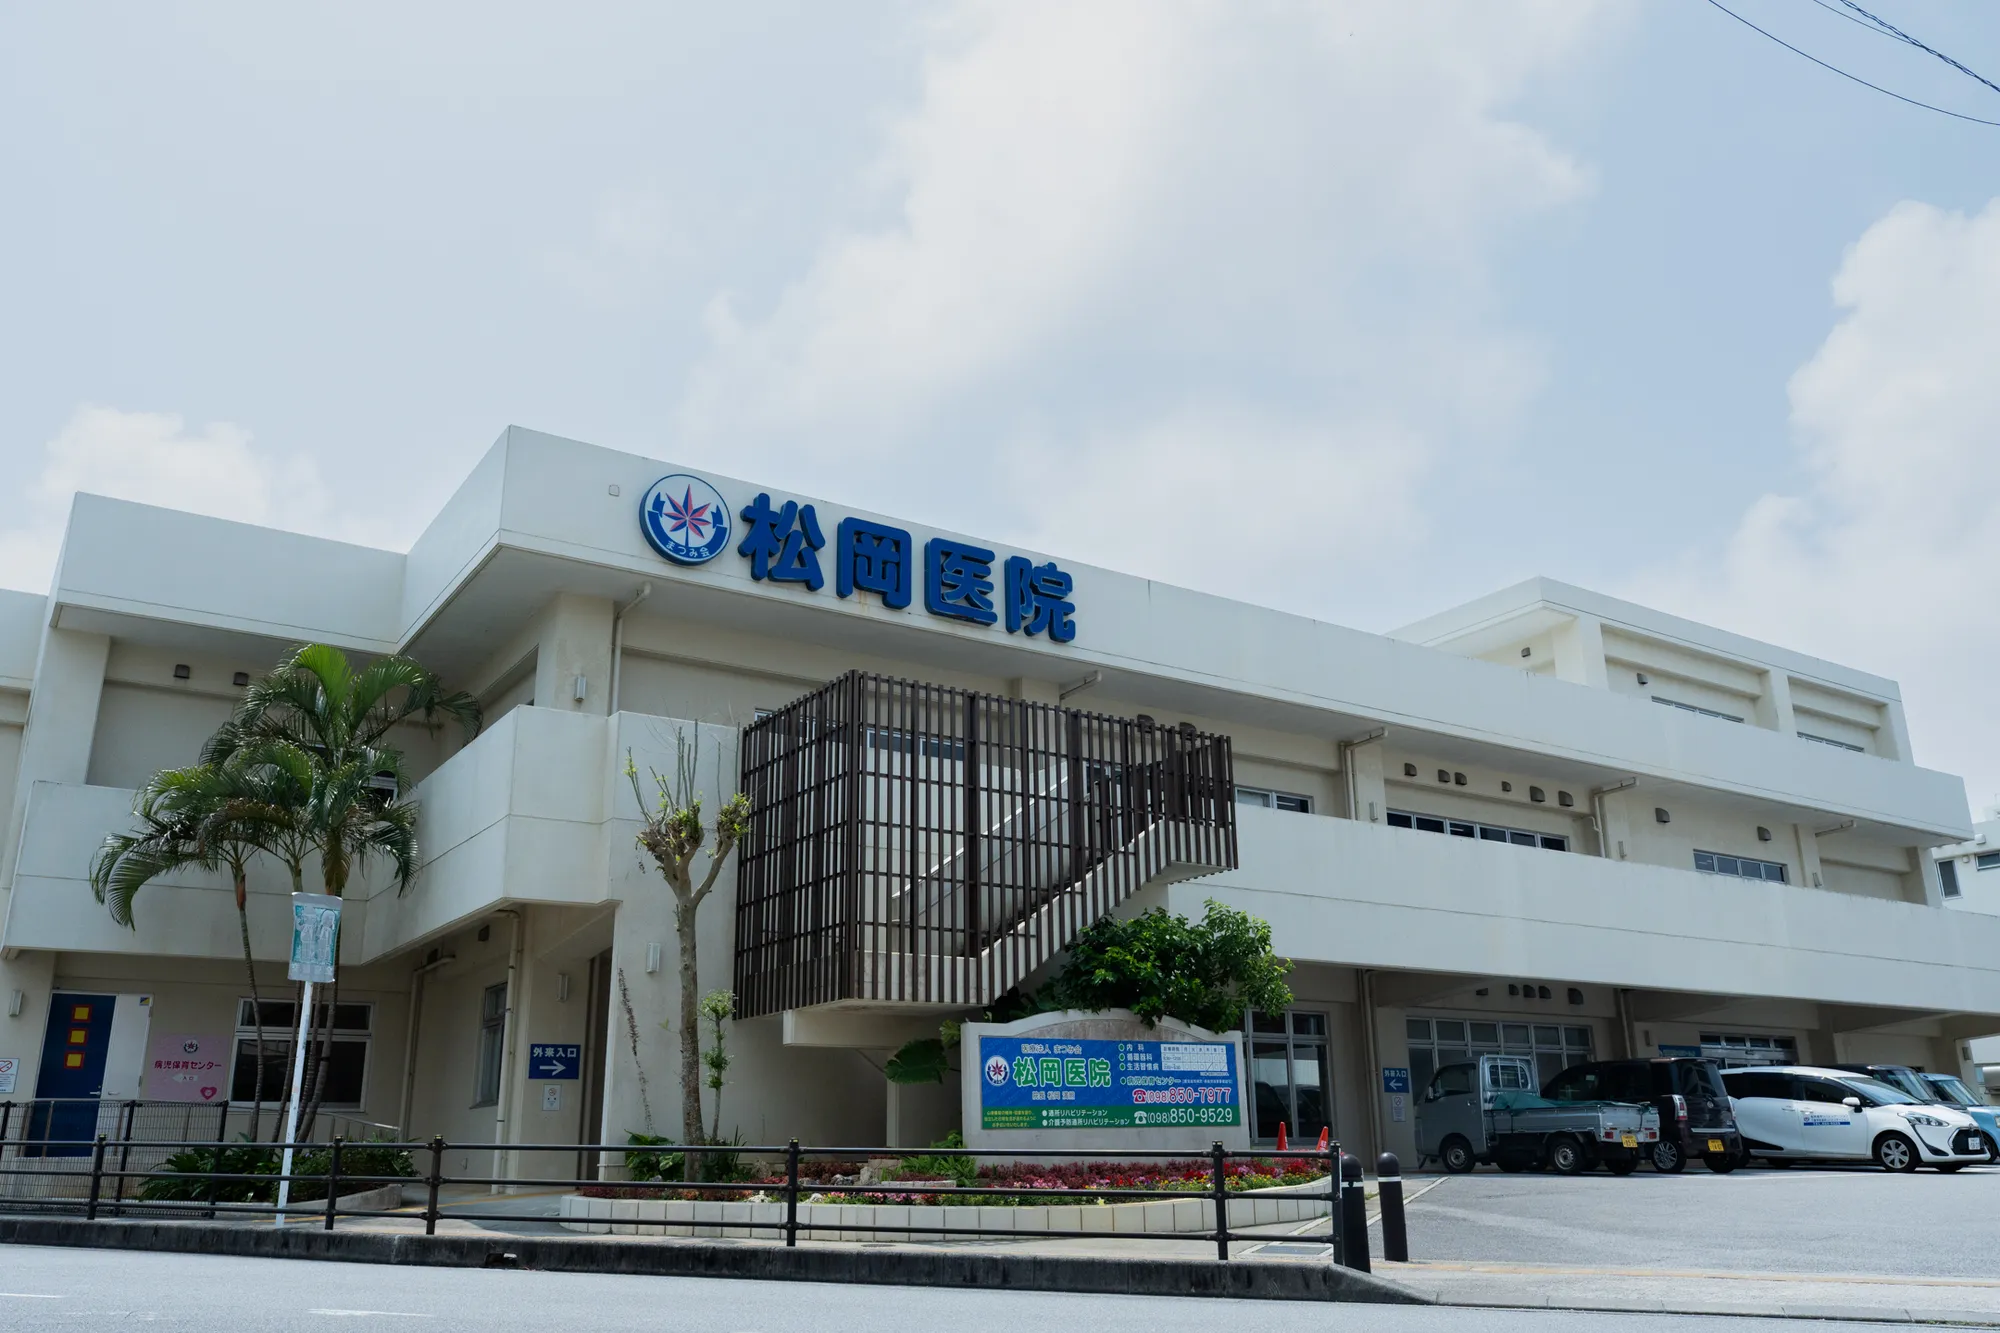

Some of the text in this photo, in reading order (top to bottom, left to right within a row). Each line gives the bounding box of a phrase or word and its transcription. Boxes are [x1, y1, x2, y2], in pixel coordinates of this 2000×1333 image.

[666, 540, 710, 558] まつみ会
[738, 492, 1076, 643] 松岡医院
[533, 1047, 577, 1058] 外来入口
[155, 1060, 222, 1070] 病児保育センター
[1013, 1056, 1111, 1087] 松岡医院
